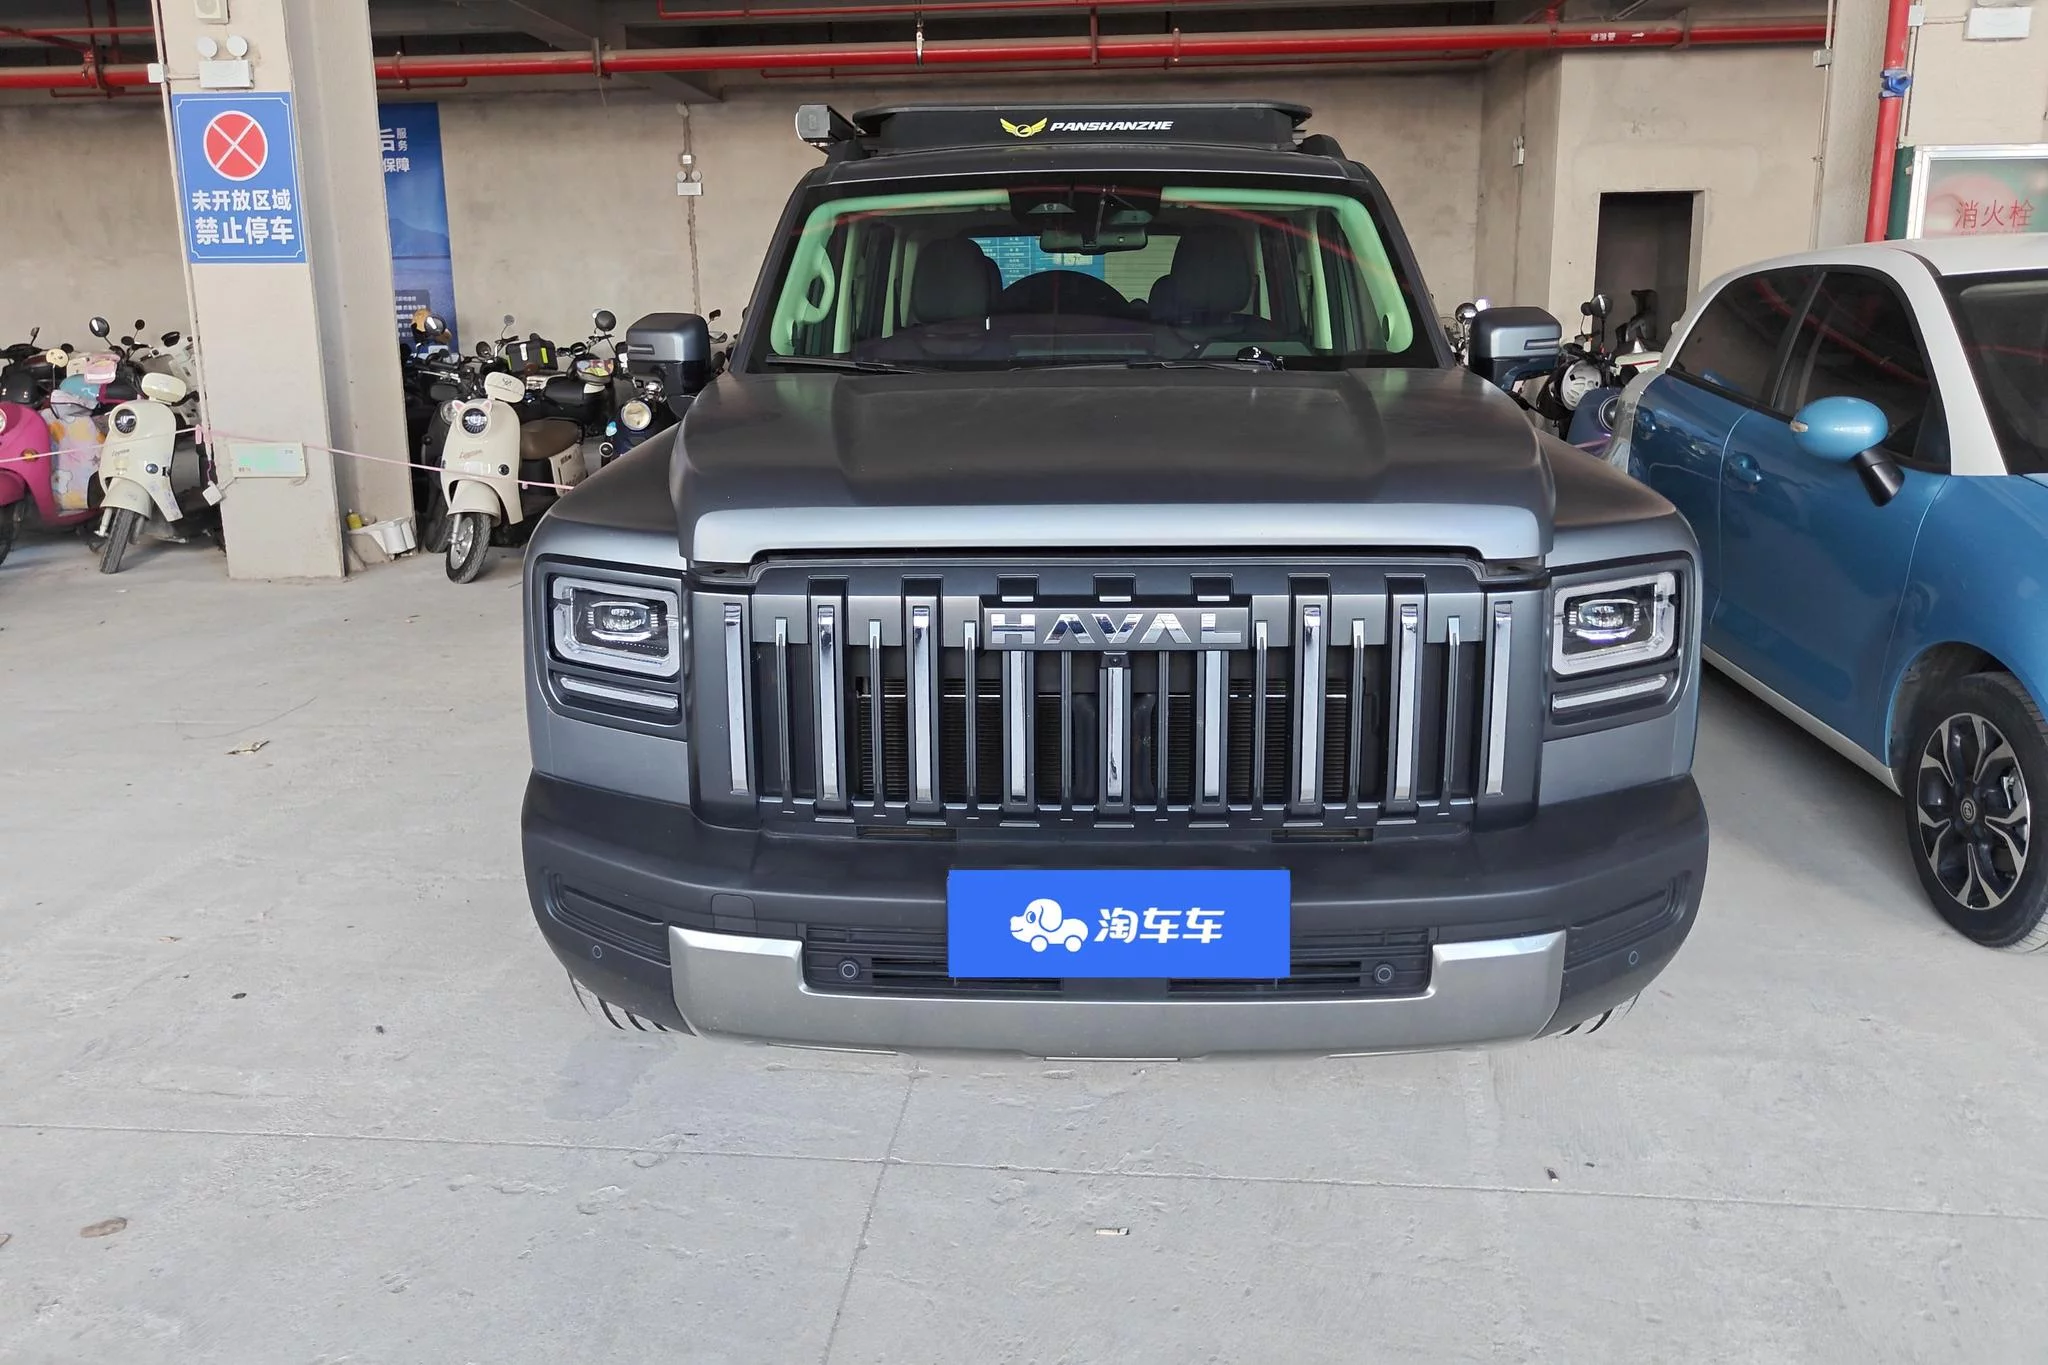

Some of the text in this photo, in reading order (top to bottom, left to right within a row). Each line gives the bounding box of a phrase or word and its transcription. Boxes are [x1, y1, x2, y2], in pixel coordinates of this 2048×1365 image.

[1050, 121, 1174, 132] PANSHANZHE
[384, 157, 410, 173] 保障
[191, 188, 292, 212] 未开放区域
[1955, 198, 2034, 229] 消火栓
[195, 216, 295, 245] 禁止停车
[991, 613, 1242, 644] HAVAL
